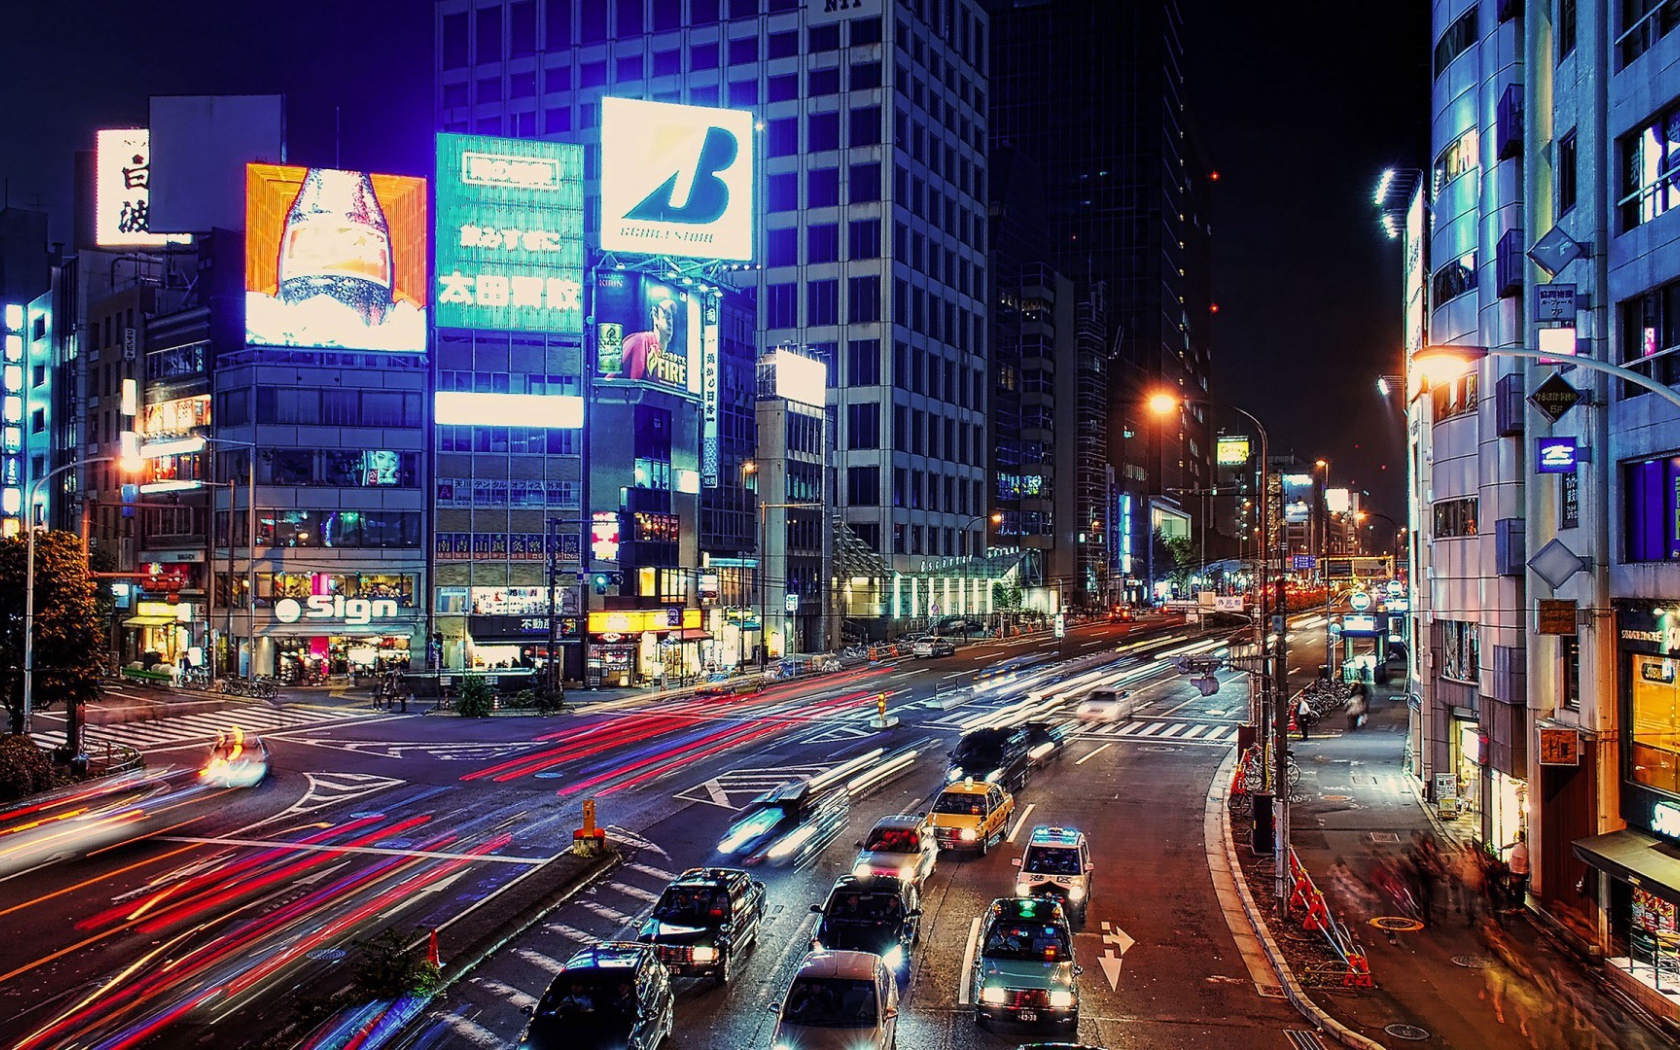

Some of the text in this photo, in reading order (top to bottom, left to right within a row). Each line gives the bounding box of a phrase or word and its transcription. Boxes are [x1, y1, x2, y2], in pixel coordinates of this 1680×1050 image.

[657, 357, 687, 384] FIRE
[438, 540, 577, 552] 南青山鍼灸整院
[306, 594, 398, 625] Sign
